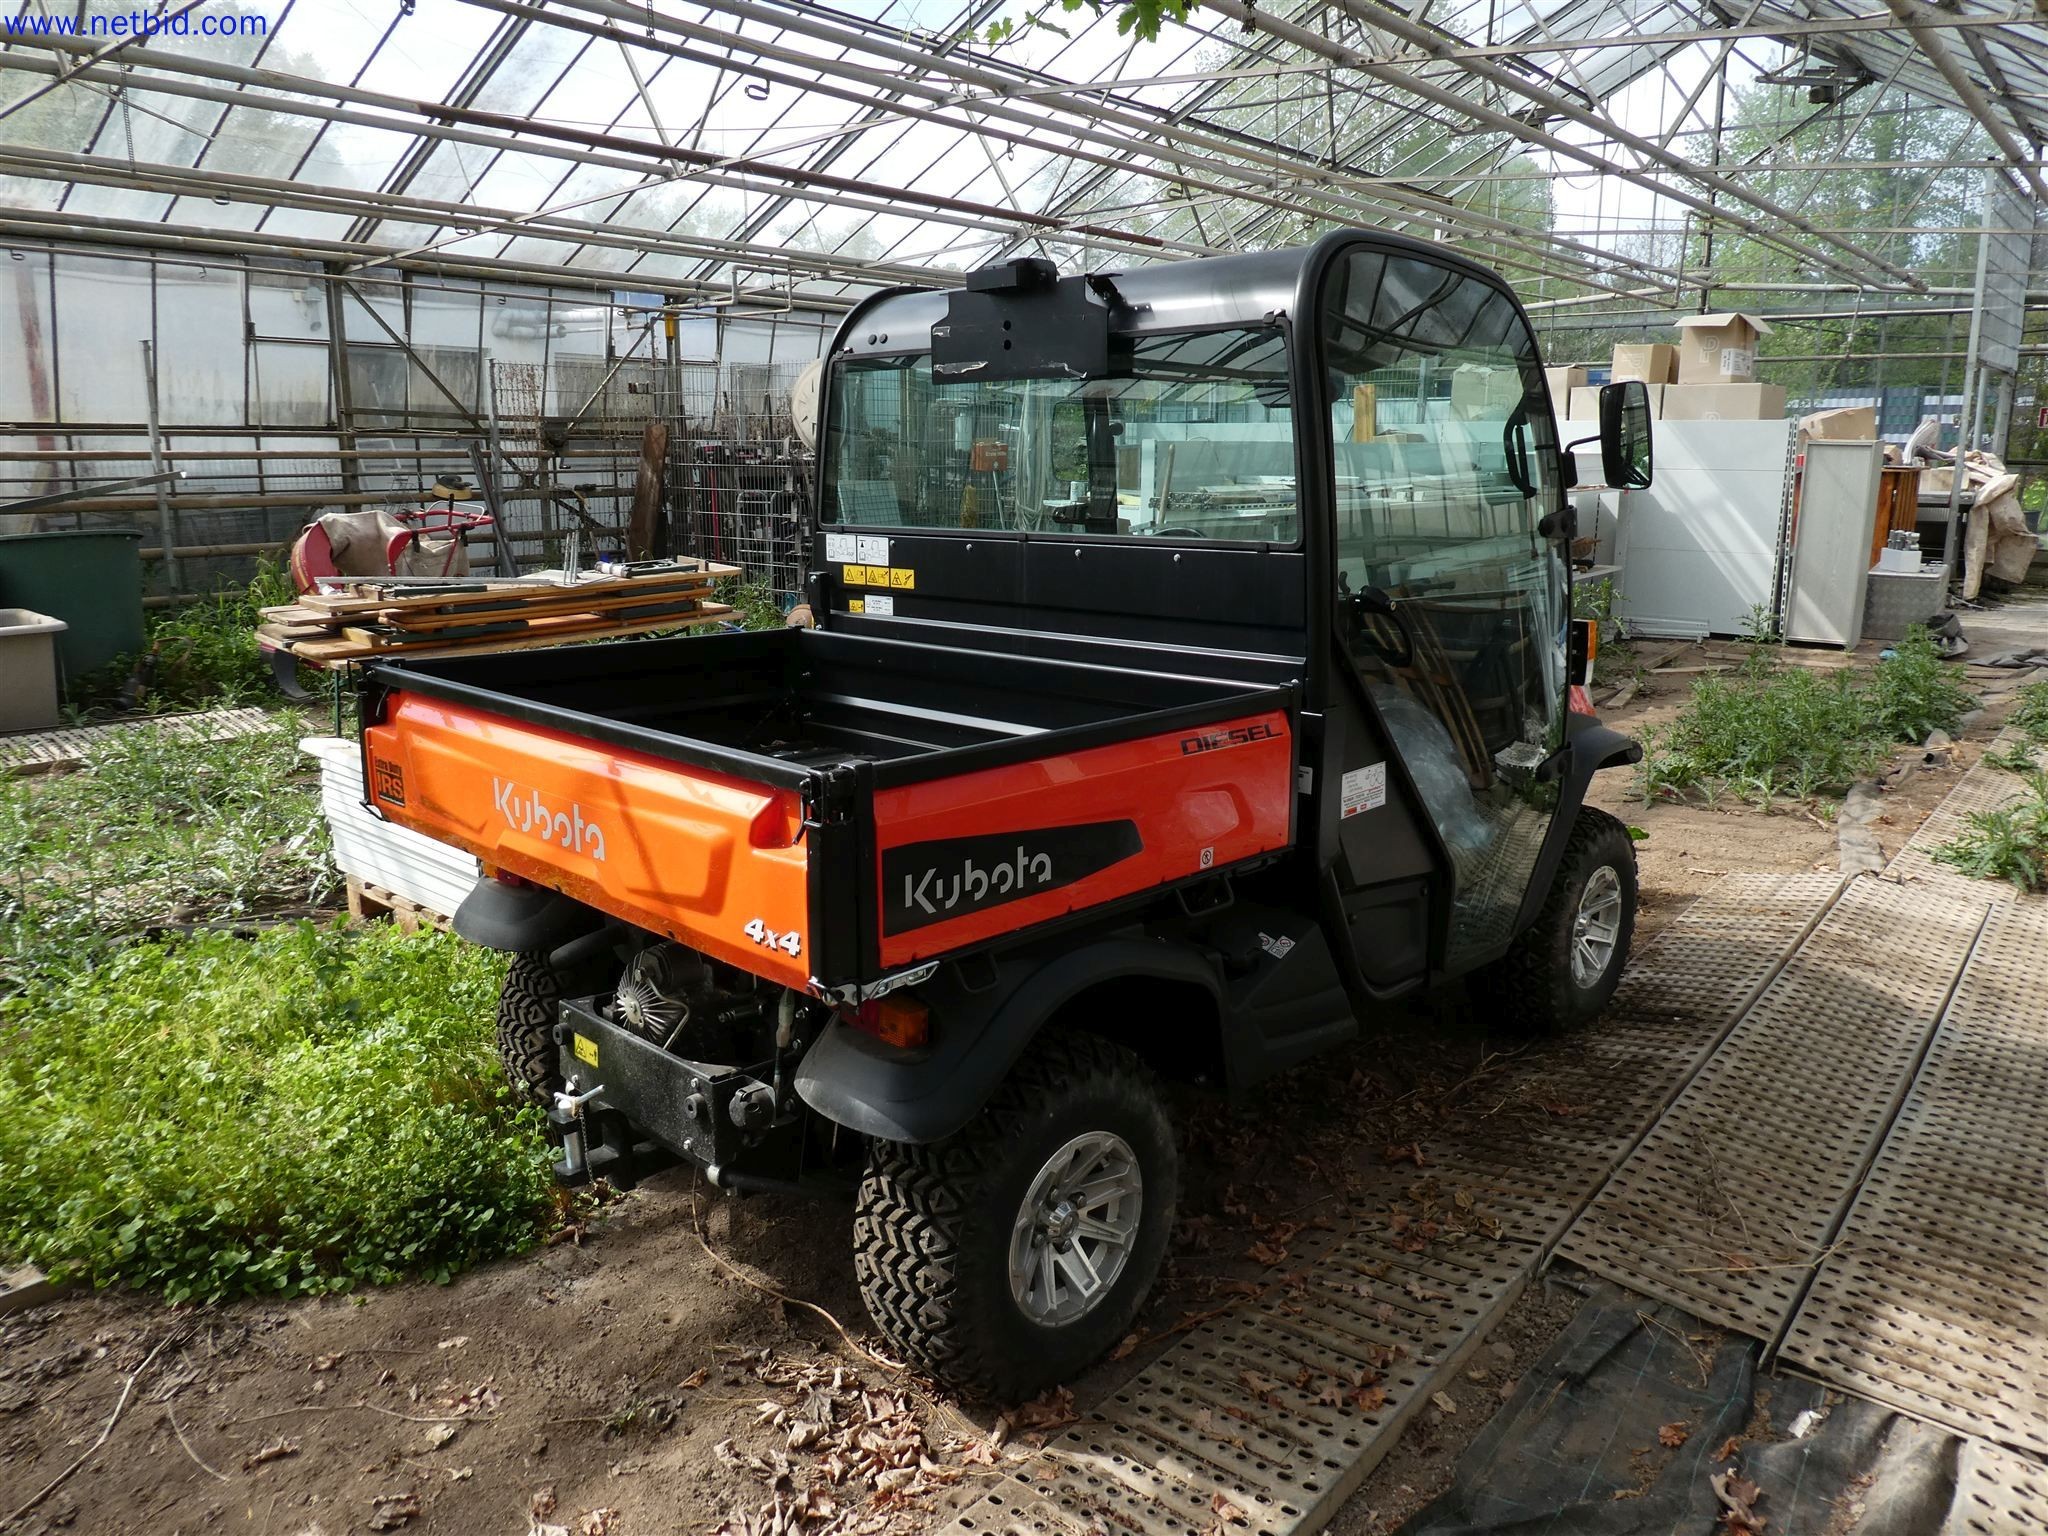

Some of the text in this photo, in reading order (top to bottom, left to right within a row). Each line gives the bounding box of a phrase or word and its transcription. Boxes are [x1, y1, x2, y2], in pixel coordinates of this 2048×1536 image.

[1181, 723, 1283, 755] DIESEL
[377, 772, 404, 799] IRS
[493, 777, 605, 861] Kubota
[904, 845, 1052, 914] Kubota
[743, 918, 801, 958] 4x4
